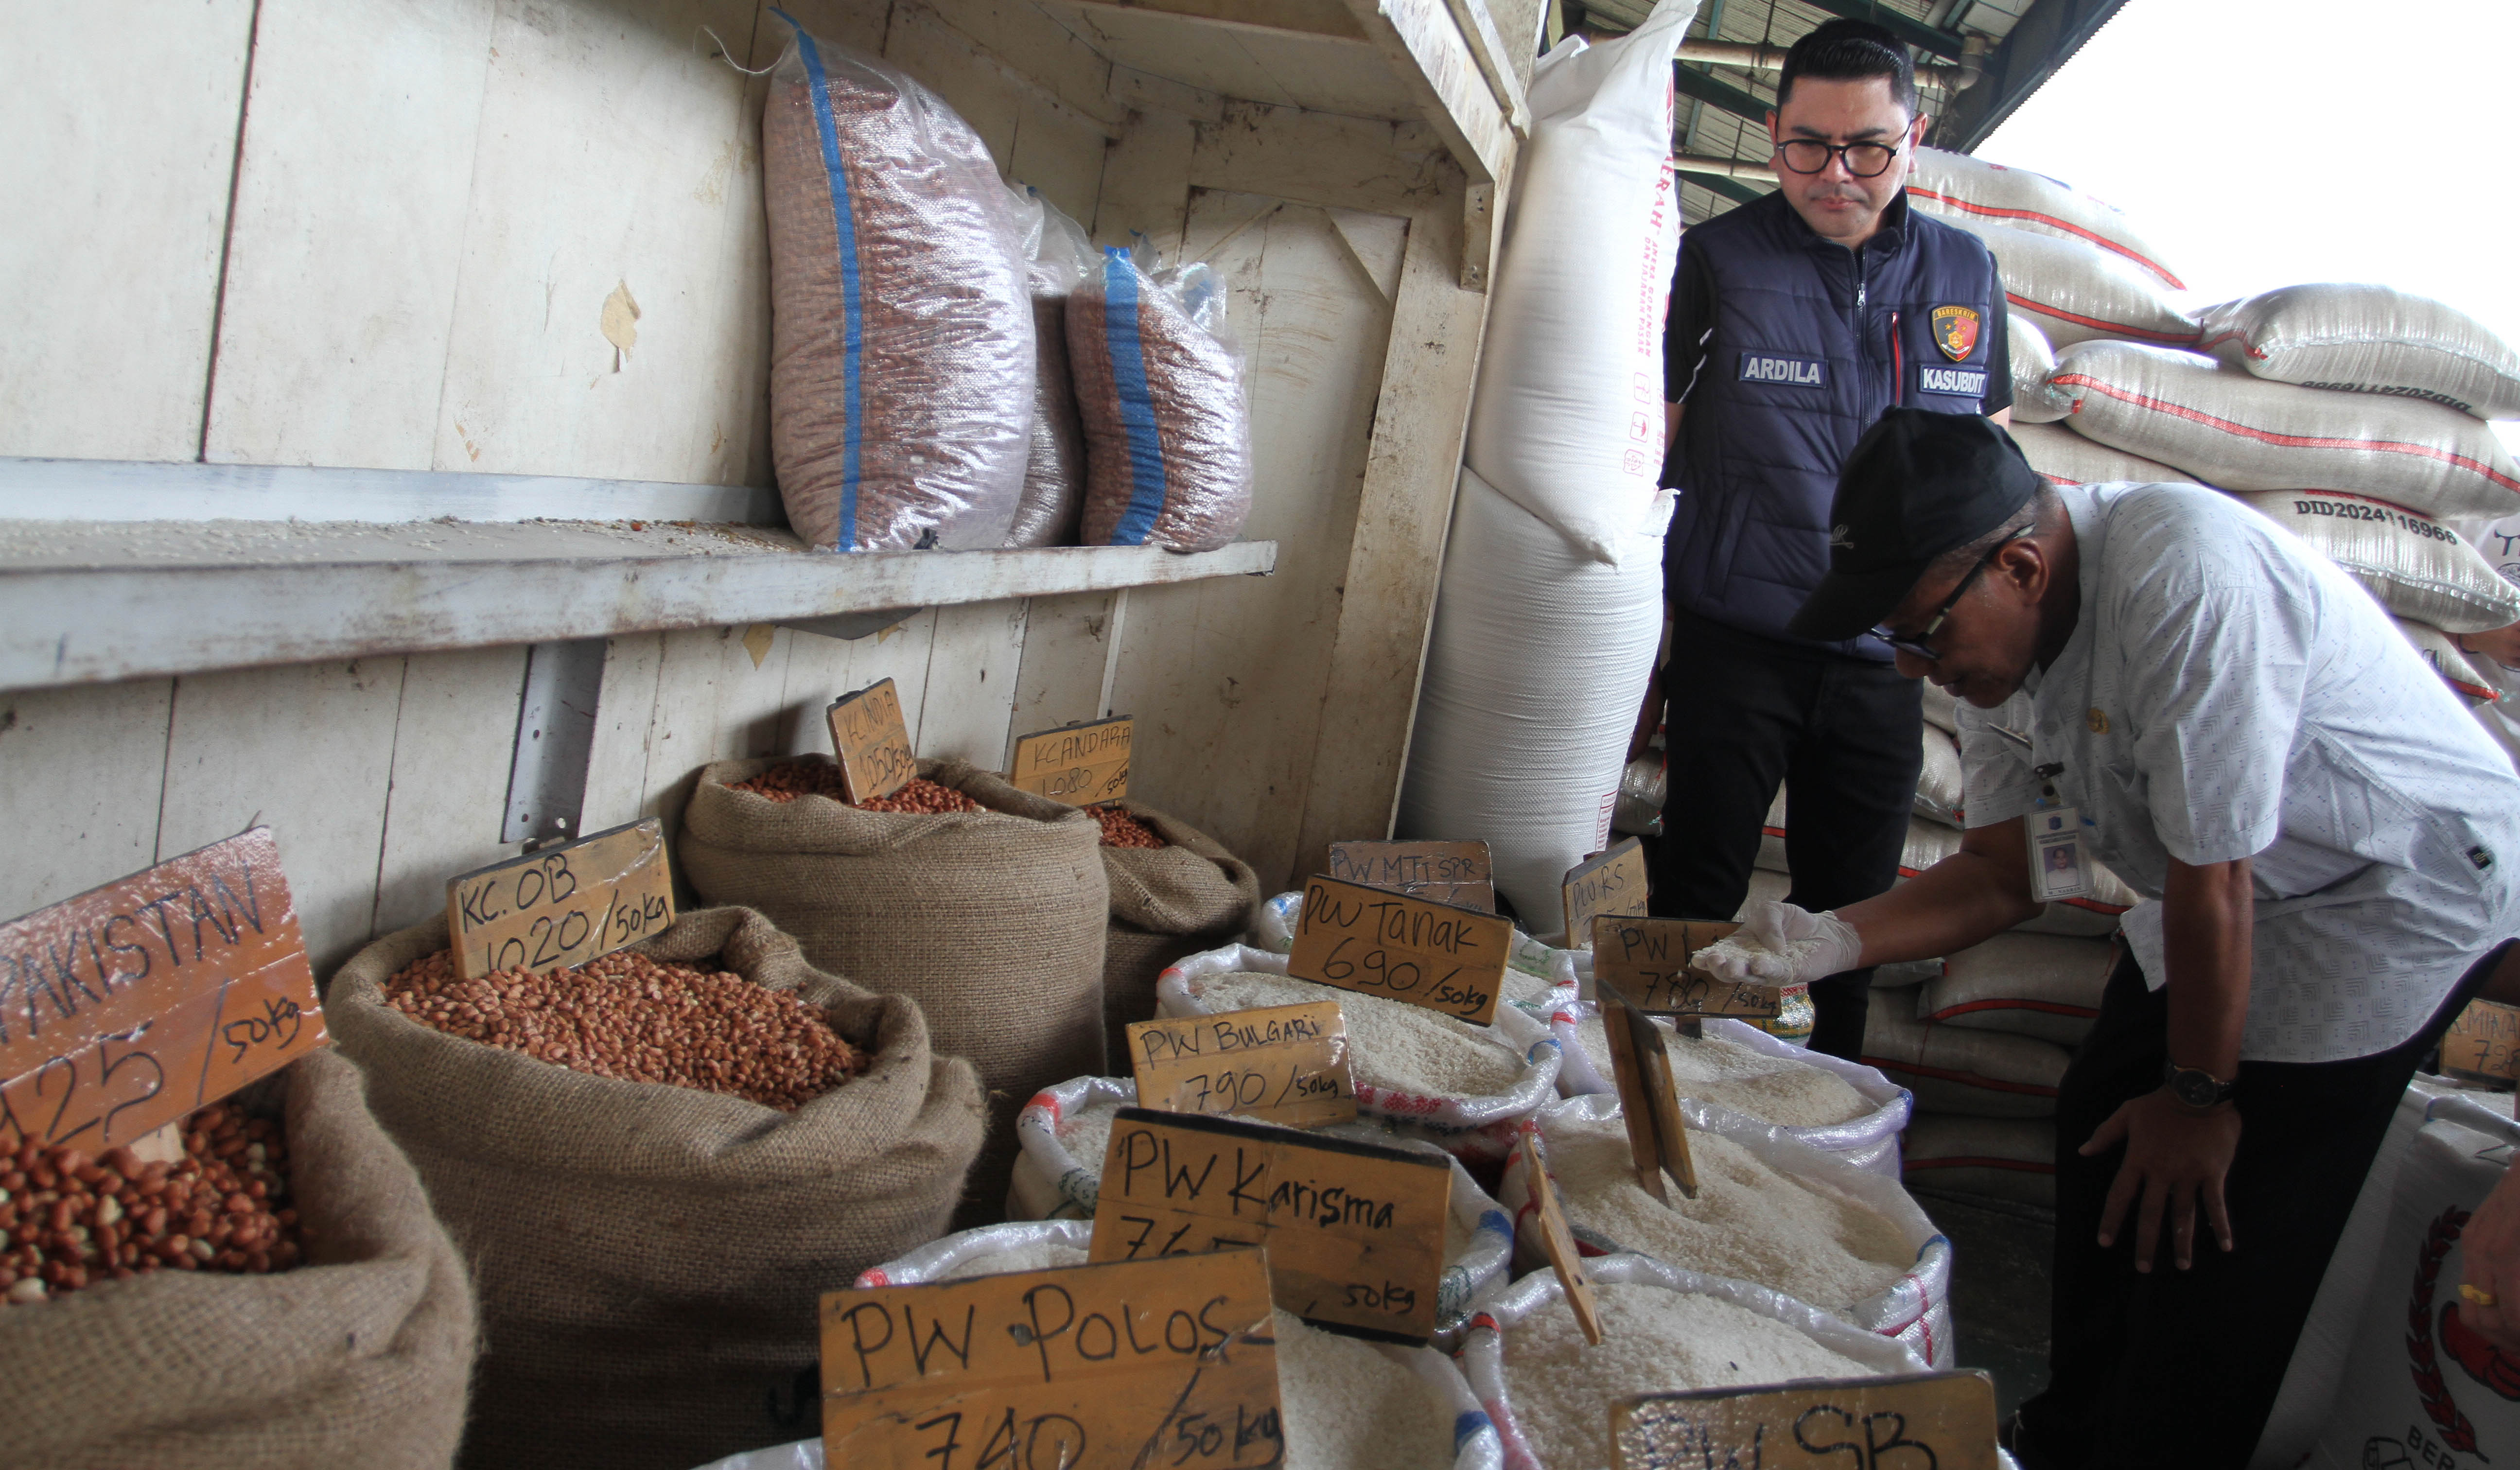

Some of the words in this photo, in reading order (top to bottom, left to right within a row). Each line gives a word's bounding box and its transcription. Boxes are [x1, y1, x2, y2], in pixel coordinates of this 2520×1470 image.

[1650, 152, 1673, 228] ERAH
[1649, 240, 1658, 279] ANEKA
[1937, 308, 1976, 319] BARESKRIM
[1744, 357, 1820, 384] ARDILA
[1923, 368, 1985, 394] KASUBDIT
[1330, 848, 1374, 881] PW
[1438, 857, 1475, 878] SPR
[1303, 884, 1363, 935] PW
[1369, 901, 1478, 954] Tanak
[1621, 927, 1667, 963] PW
[1139, 1028, 1200, 1069] PW
[1124, 1130, 1218, 1200] PW
[1227, 1148, 1394, 1229] Karisma
[841, 1300, 975, 1388] PW
[1792, 1403, 1938, 1470] SB
